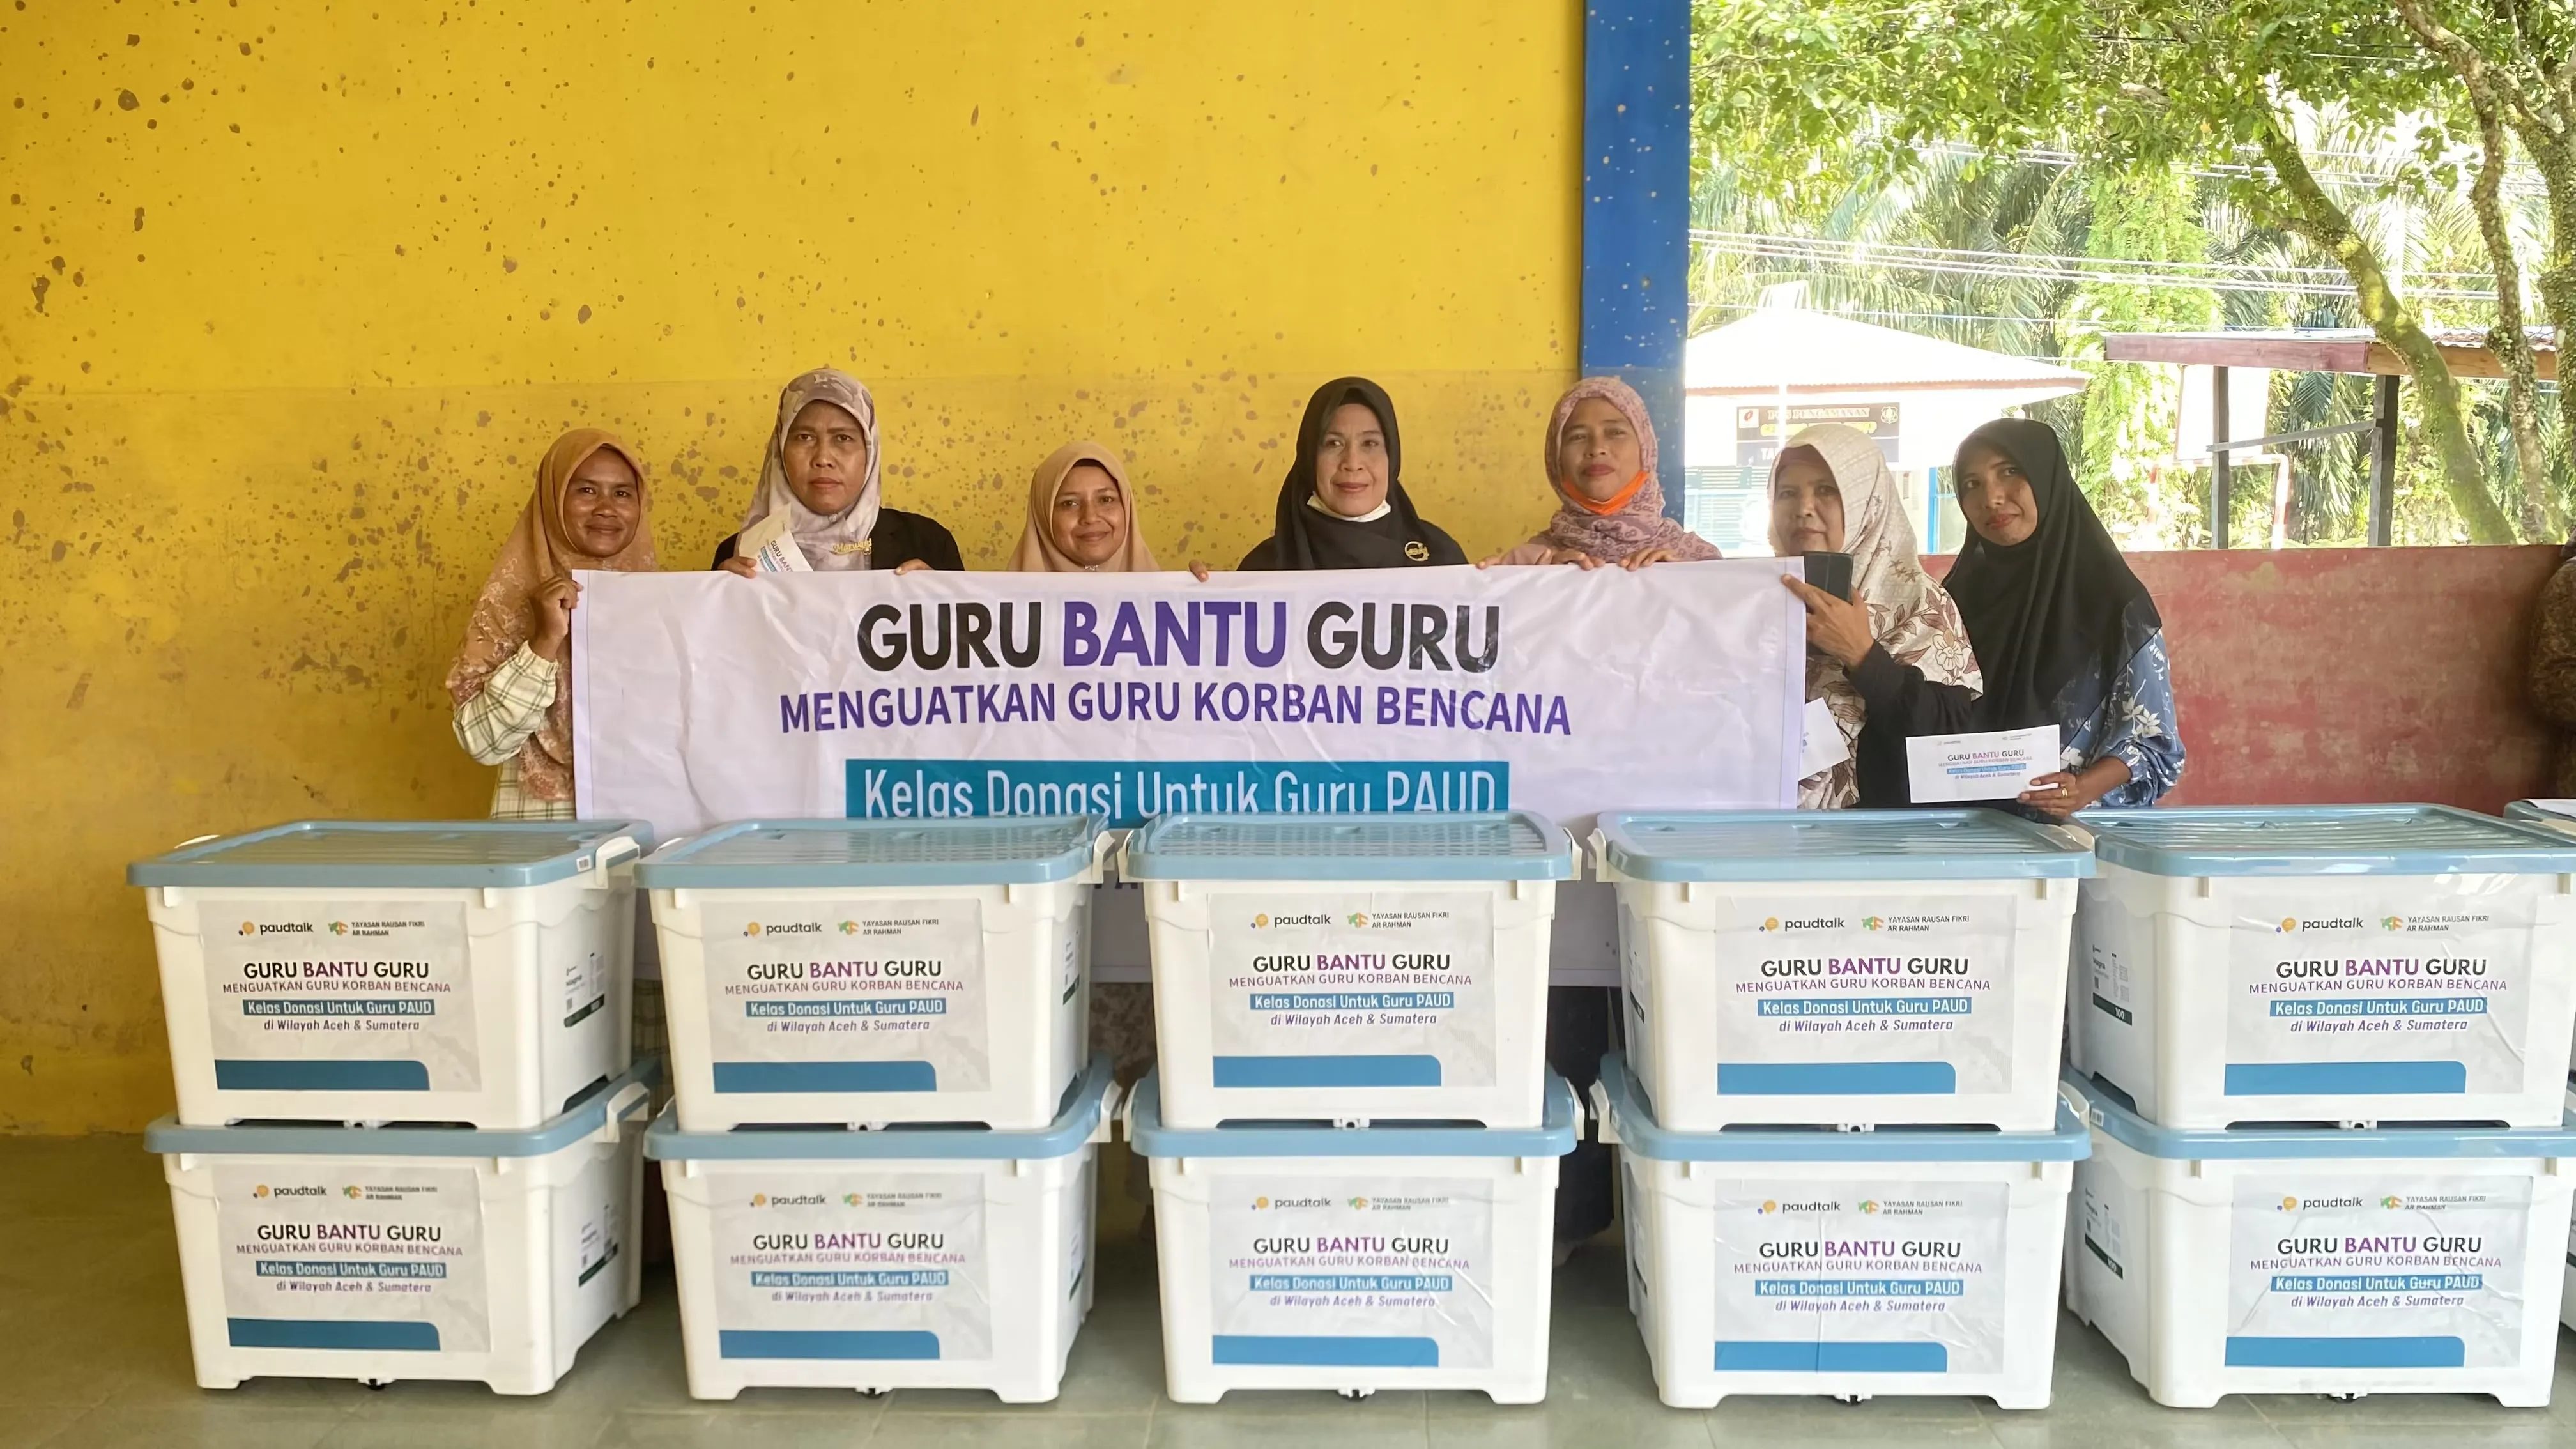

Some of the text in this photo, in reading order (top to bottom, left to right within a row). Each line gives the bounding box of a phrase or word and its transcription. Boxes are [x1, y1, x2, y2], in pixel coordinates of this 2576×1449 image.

[770, 540, 782, 557] GURU
[858, 601, 1499, 673] GURU BANTU GURU
[780, 682, 1571, 735] MENGUATKAN GURU KORBAN BENCANA
[865, 769, 1495, 819] Kelas Donasi Untuk Guru PAUD
[260, 922, 313, 935] paudtalk
[1275, 915, 1331, 928] paudtalk
[1785, 917, 1844, 931] paudtalk
[2303, 918, 2363, 931] paudtalk
[767, 923, 821, 935] paudtalk
[244, 962, 429, 978] GURU BANTU GURU
[747, 961, 941, 979] GURU BANTU GURU
[1254, 954, 1450, 972] GURU BANTU GURU
[1761, 959, 1968, 976] GURU BANTU GURU
[2276, 959, 2486, 977] GURU BANTU GURU
[224, 981, 451, 993] MENGUATKAN GURU KORBAN BENCANA
[726, 981, 963, 994] MENGUATKAN GURU KORBAN BENCANA
[1230, 974, 1471, 988] MENGUATKAN GURU KORBAN BENCANA
[1736, 979, 1990, 993] MENGUATKAN GURU KORBAN BENCANA
[2250, 979, 2506, 993] MENGUATKAN GURU KORBAN BENCANA
[248, 1001, 431, 1014] Kelas Donasi Untuk Guru PAUD
[751, 1000, 942, 1015] Kelas Donasi Untuk Guru PAUD
[1255, 993, 1450, 1008] Kelas Donasi Untuk Guru PAUD
[1764, 999, 1967, 1014] Kelas Donasi Untuk Guru PAUD
[2276, 999, 2483, 1015] Kelas Donasi Untuk Guru PAUD
[1271, 1014, 1436, 1027] di Wilayah Aceh & Sumatera
[2115, 1007, 2124, 1020] 100
[264, 1020, 419, 1032] di Wilayah Aceh & Sumatera
[767, 1020, 929, 1033] di Wilayah Aceh & Sumatera
[1779, 1020, 1952, 1033] di Wilayah Aceh & Sumatera
[2291, 1020, 2467, 1033] di Wilayah Aceh & Sumatera
[274, 1186, 326, 1198] paudtalk
[772, 1195, 826, 1207] paudtalk
[1275, 1197, 1331, 1211] paudtalk
[1783, 1200, 1841, 1214] paudtalk
[2303, 1197, 2363, 1210] paudtalk
[257, 1225, 441, 1241] GURU BANTU GURU
[754, 1234, 943, 1250] GURU BANTU GURU
[1254, 1237, 1448, 1254] GURU BANTU GURU
[1759, 1241, 1961, 1257] GURU BANTU GURU
[2278, 1237, 2481, 1254] GURU BANTU GURU
